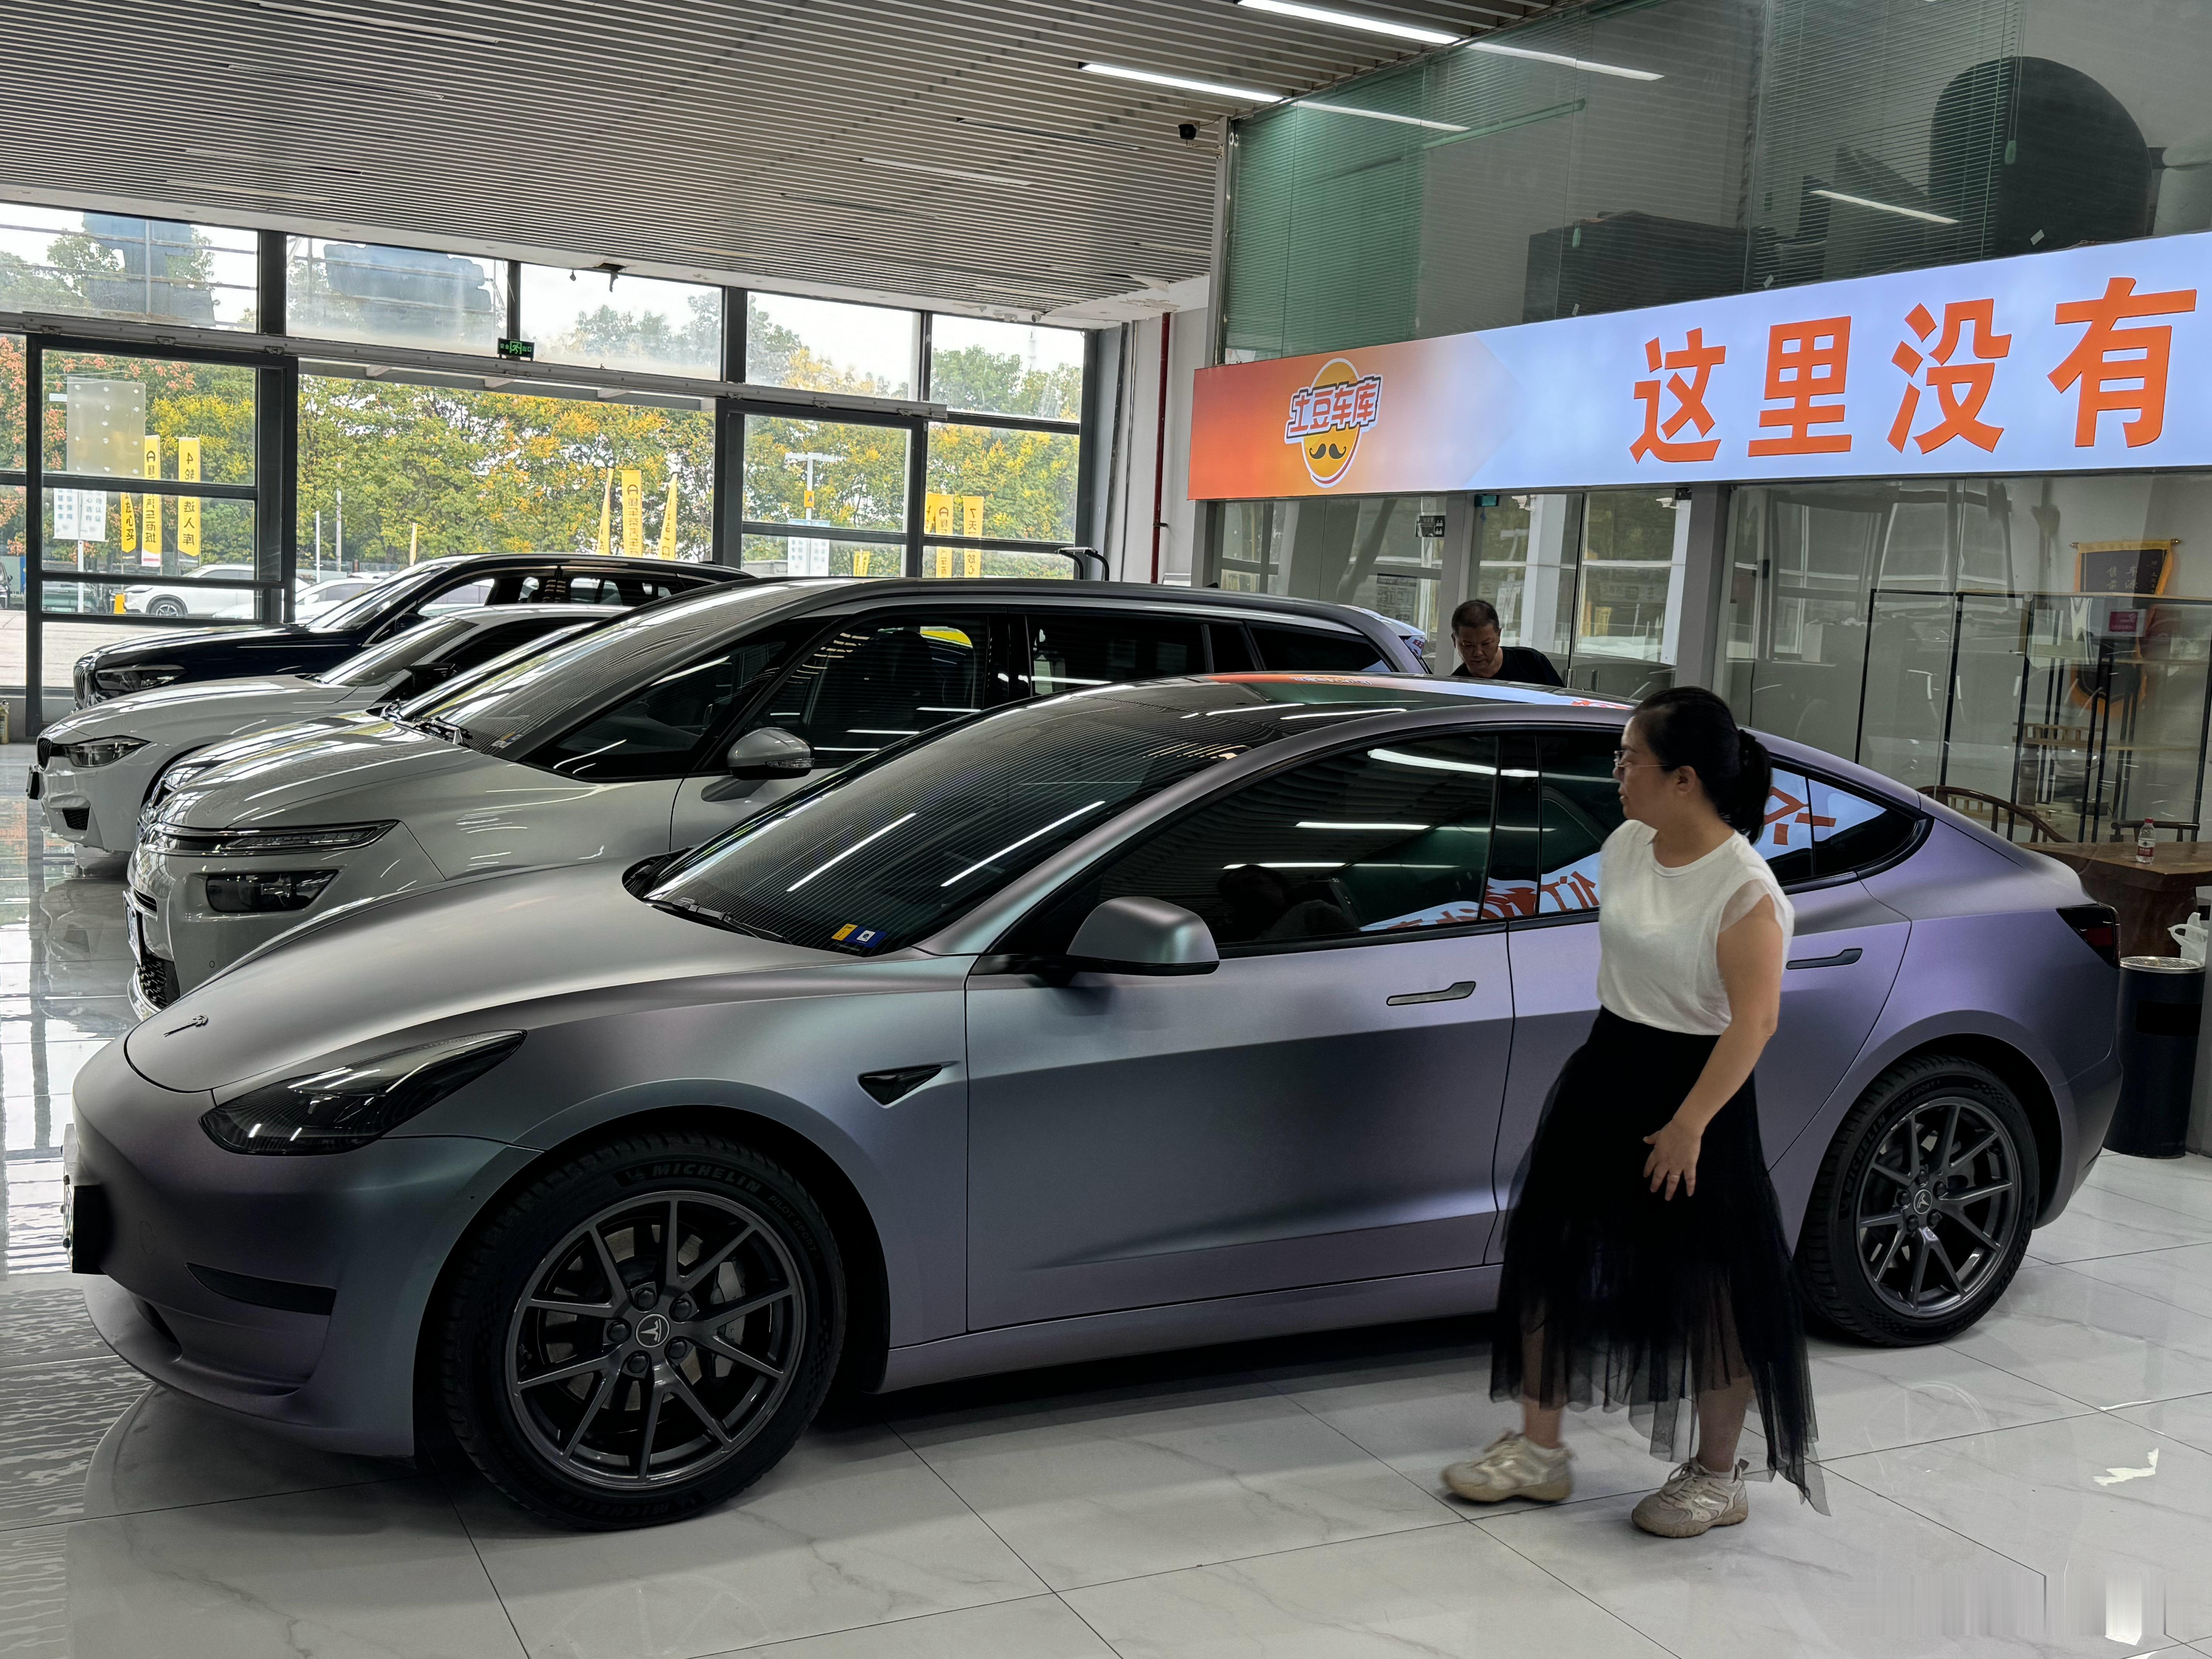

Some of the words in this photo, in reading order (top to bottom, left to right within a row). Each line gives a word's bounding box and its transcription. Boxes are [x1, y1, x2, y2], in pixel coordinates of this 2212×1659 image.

[1629, 277, 2197, 464] 这里没有
[1290, 383, 1377, 433] 土豆车库
[652, 1163, 762, 1194] MICHELIN
[1843, 1113, 1887, 1193] MICHELIN
[768, 1195, 796, 1219] PILOT
[793, 1220, 817, 1252] SPORT
